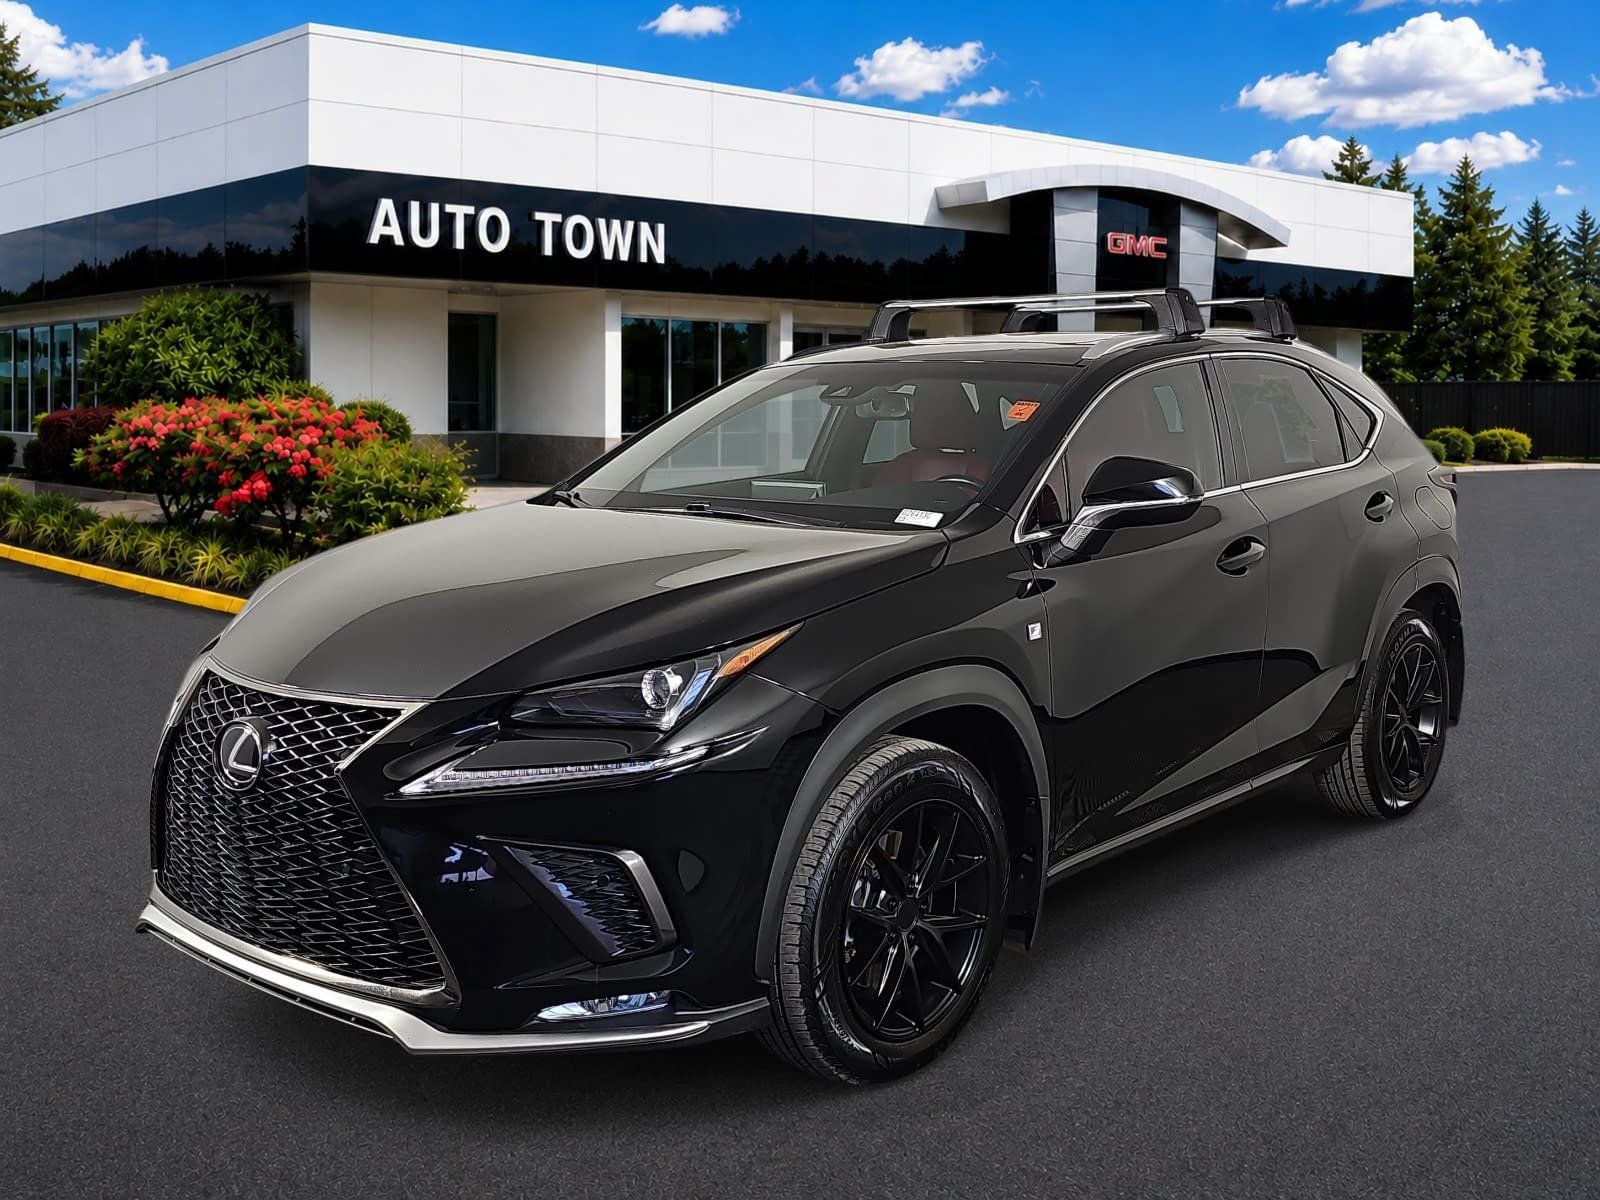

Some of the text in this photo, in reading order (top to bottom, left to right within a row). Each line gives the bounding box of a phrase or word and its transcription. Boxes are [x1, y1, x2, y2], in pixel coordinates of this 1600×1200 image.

[366, 198, 665, 264] AUTO TOWN
[1107, 232, 1168, 259] GMC
